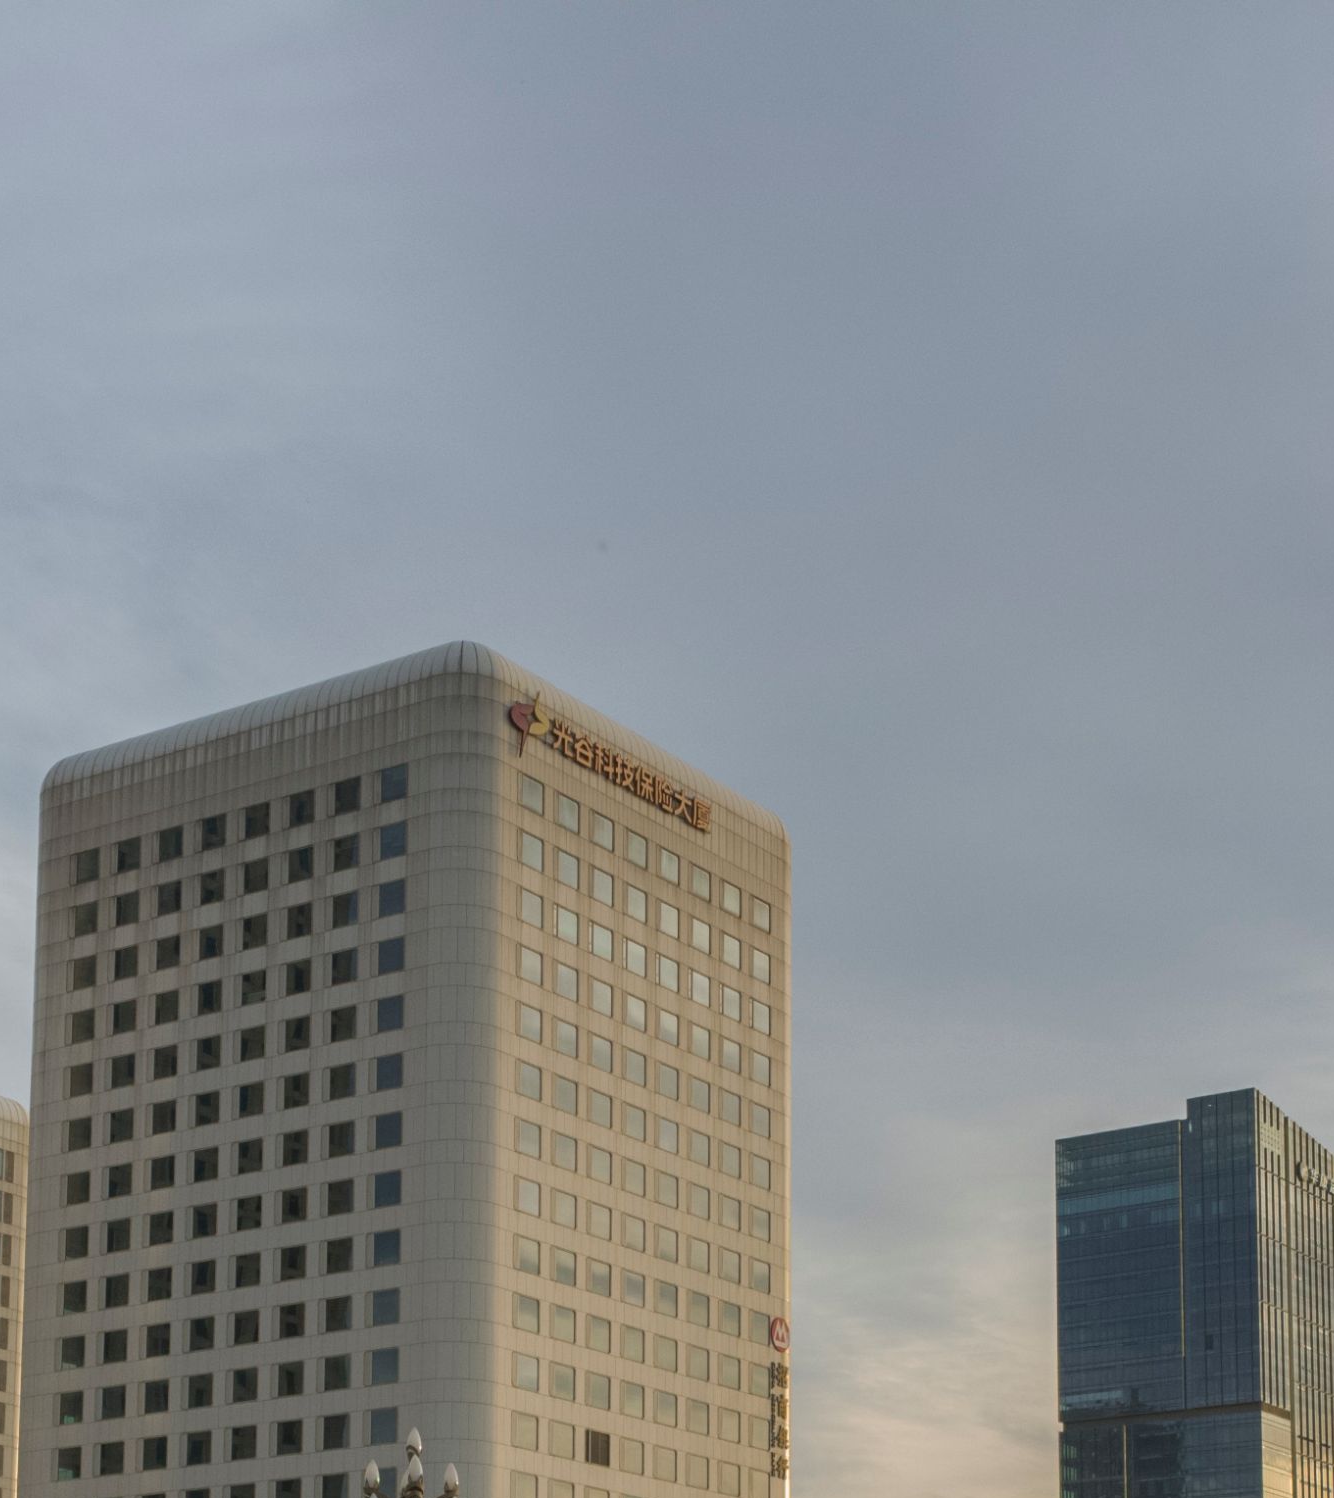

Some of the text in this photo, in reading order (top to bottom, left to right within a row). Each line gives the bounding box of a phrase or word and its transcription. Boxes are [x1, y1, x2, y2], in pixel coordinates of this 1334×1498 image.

[552, 716, 711, 834] 光谷科技保险大厦
